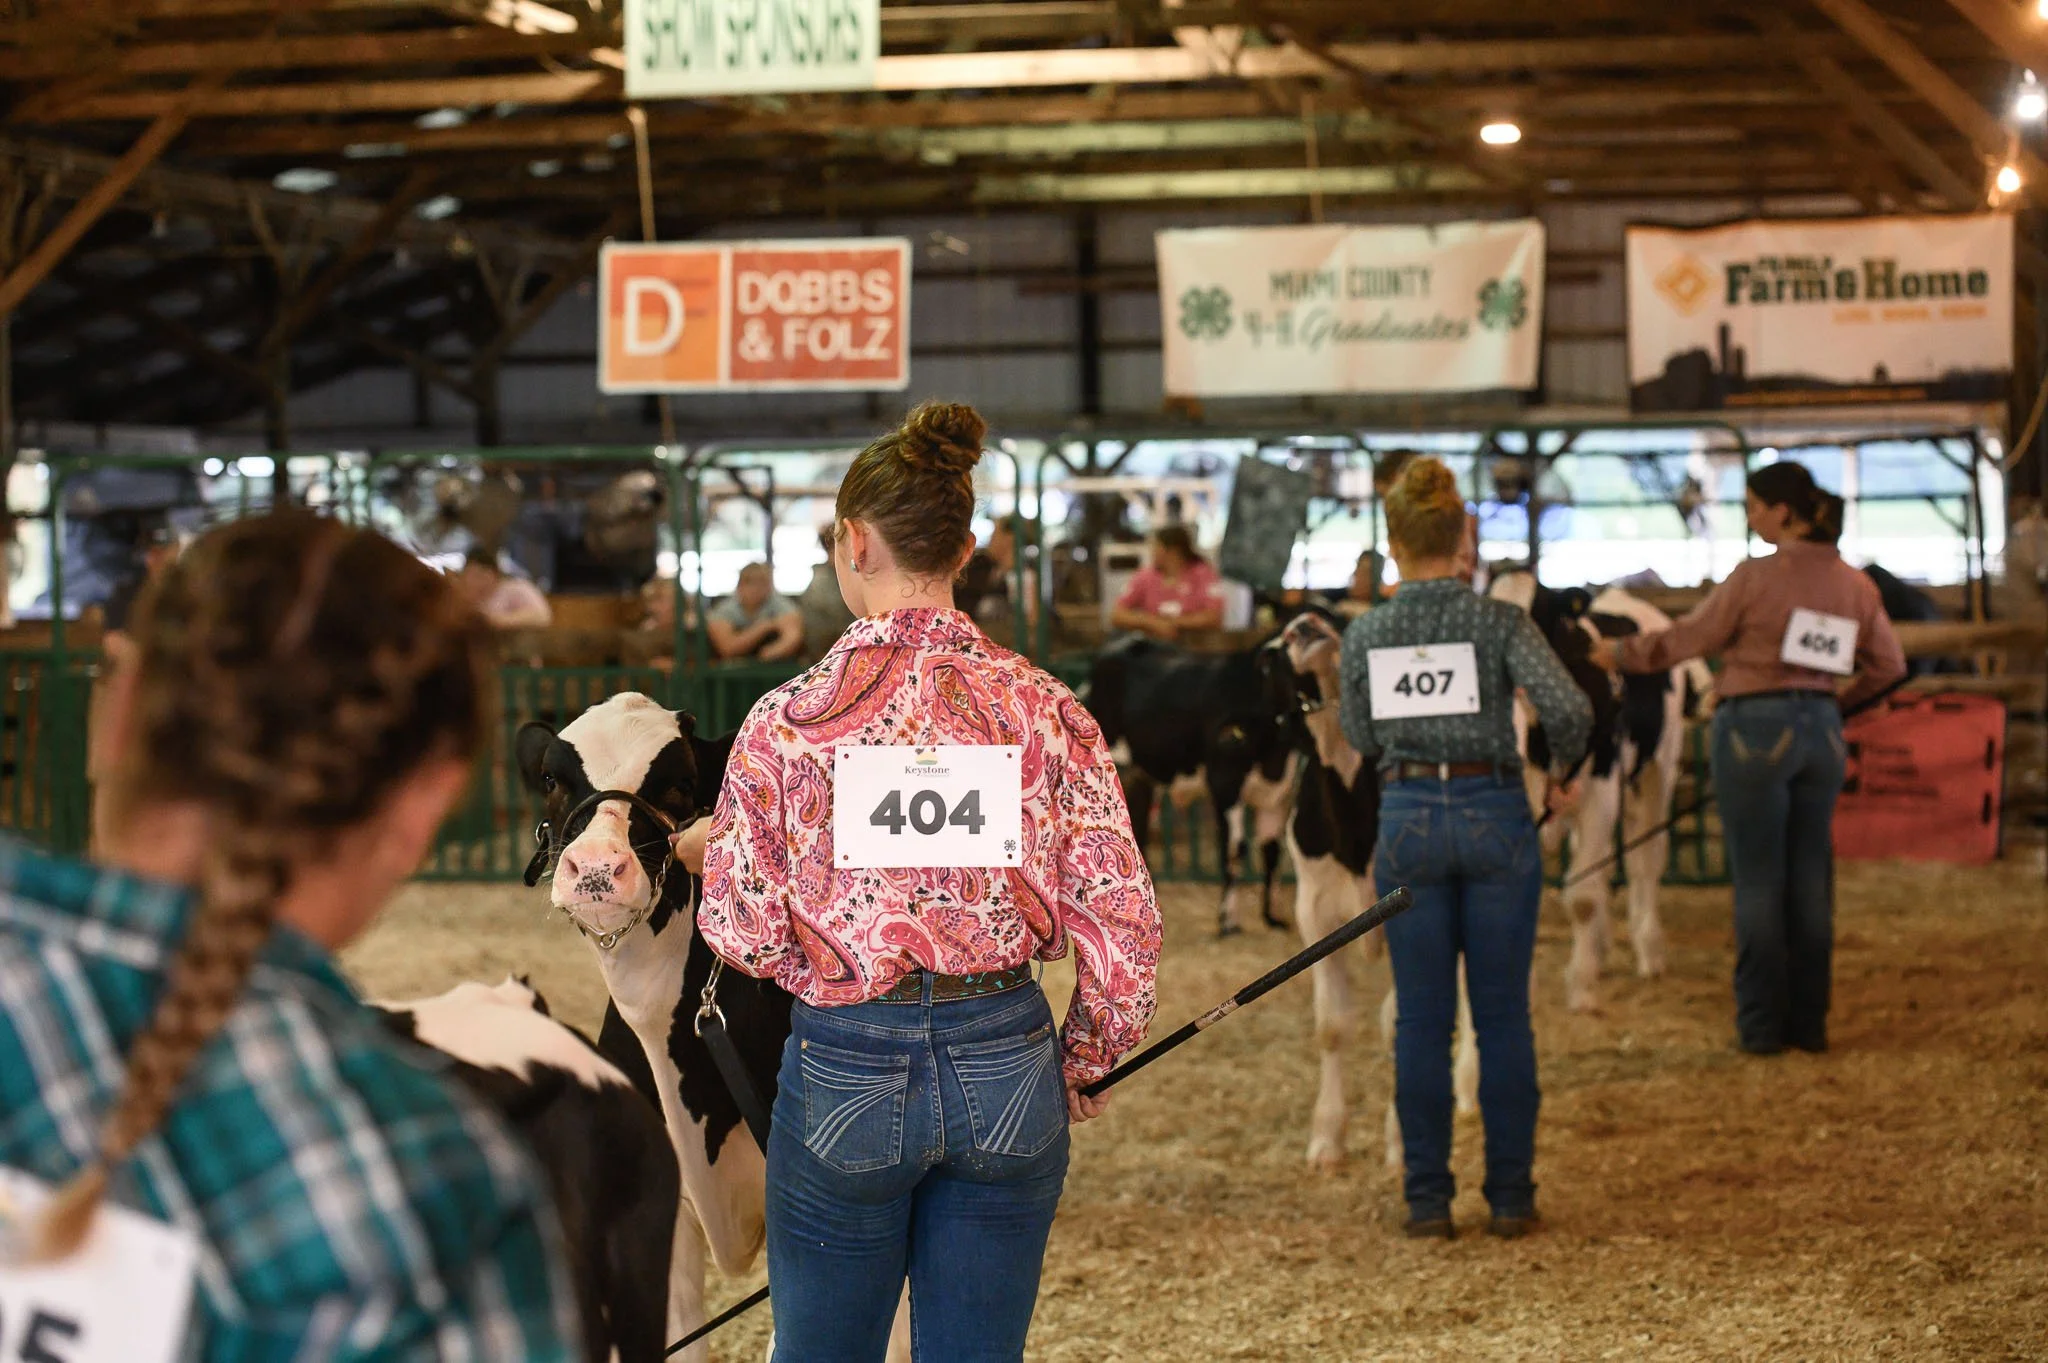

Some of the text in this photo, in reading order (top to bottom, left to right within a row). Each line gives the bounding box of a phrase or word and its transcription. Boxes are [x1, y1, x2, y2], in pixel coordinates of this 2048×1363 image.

[737, 268, 895, 315] DOBBS
[1346, 264, 1433, 300] COUNTY
[622, 276, 686, 357] D
[738, 315, 893, 362] & FOLZ
[1393, 670, 1455, 697] 407
[904, 765, 950, 777] Keystone
[869, 789, 986, 836] 404
